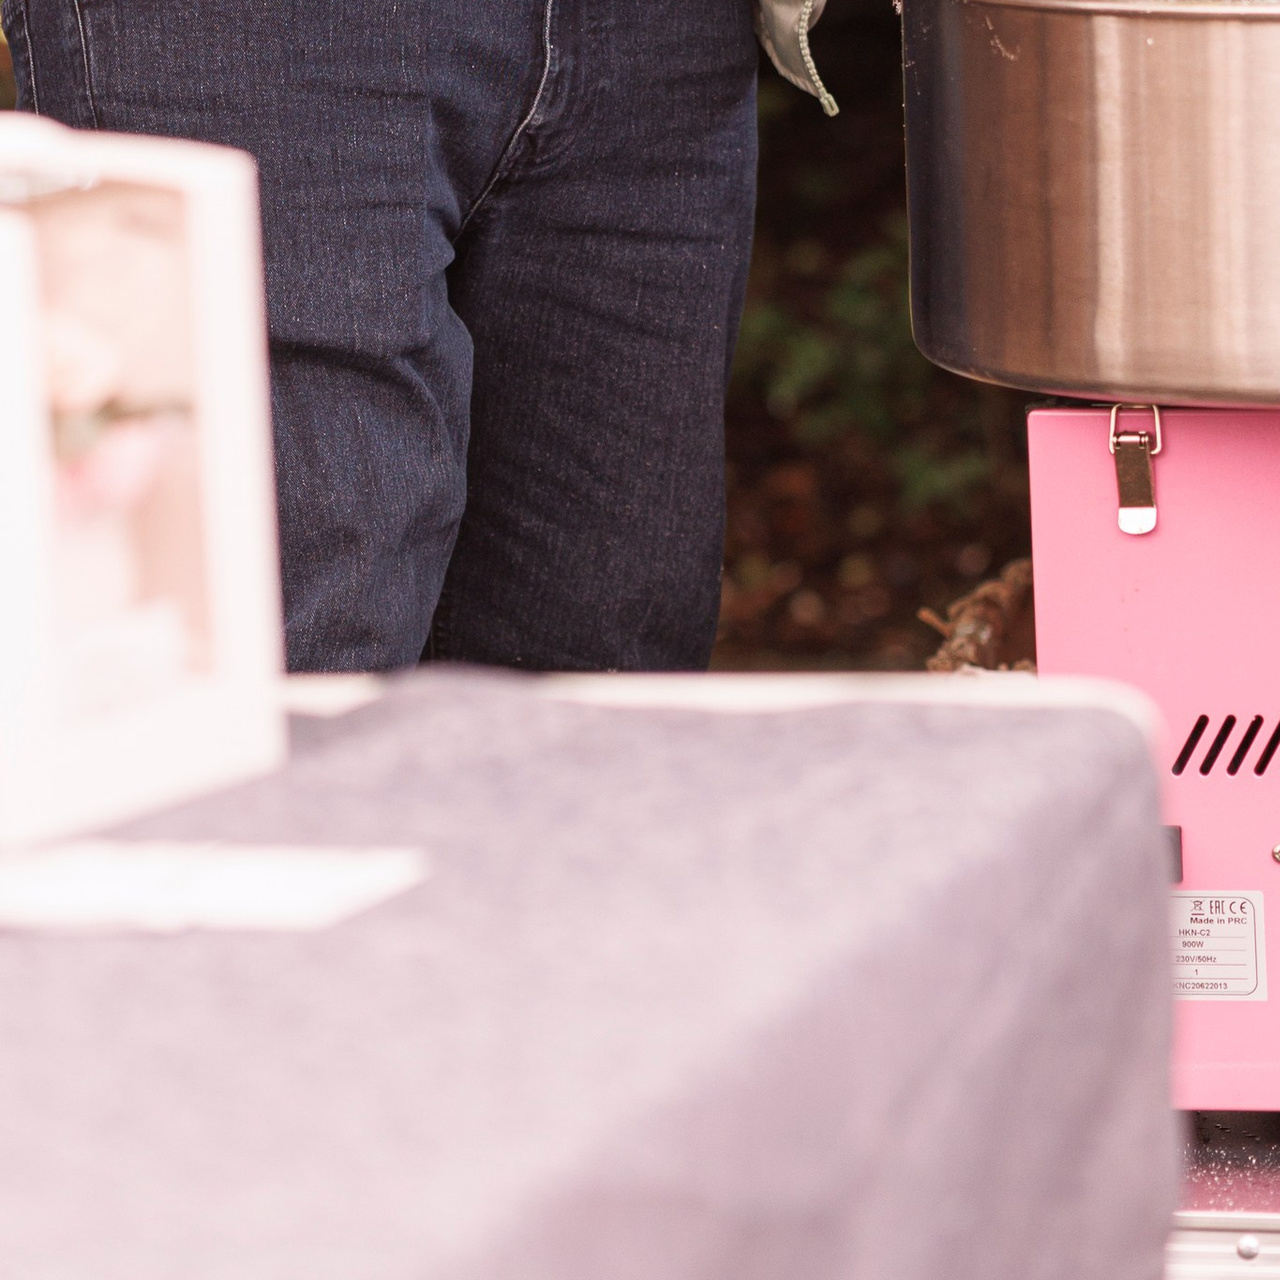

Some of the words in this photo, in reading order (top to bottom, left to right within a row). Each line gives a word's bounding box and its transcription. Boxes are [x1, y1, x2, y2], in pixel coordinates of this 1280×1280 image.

[1228, 917, 1247, 925] PRC
[1178, 928, 1211, 937] HKN-C2
[1175, 955, 1217, 963] 230V/50Hz
